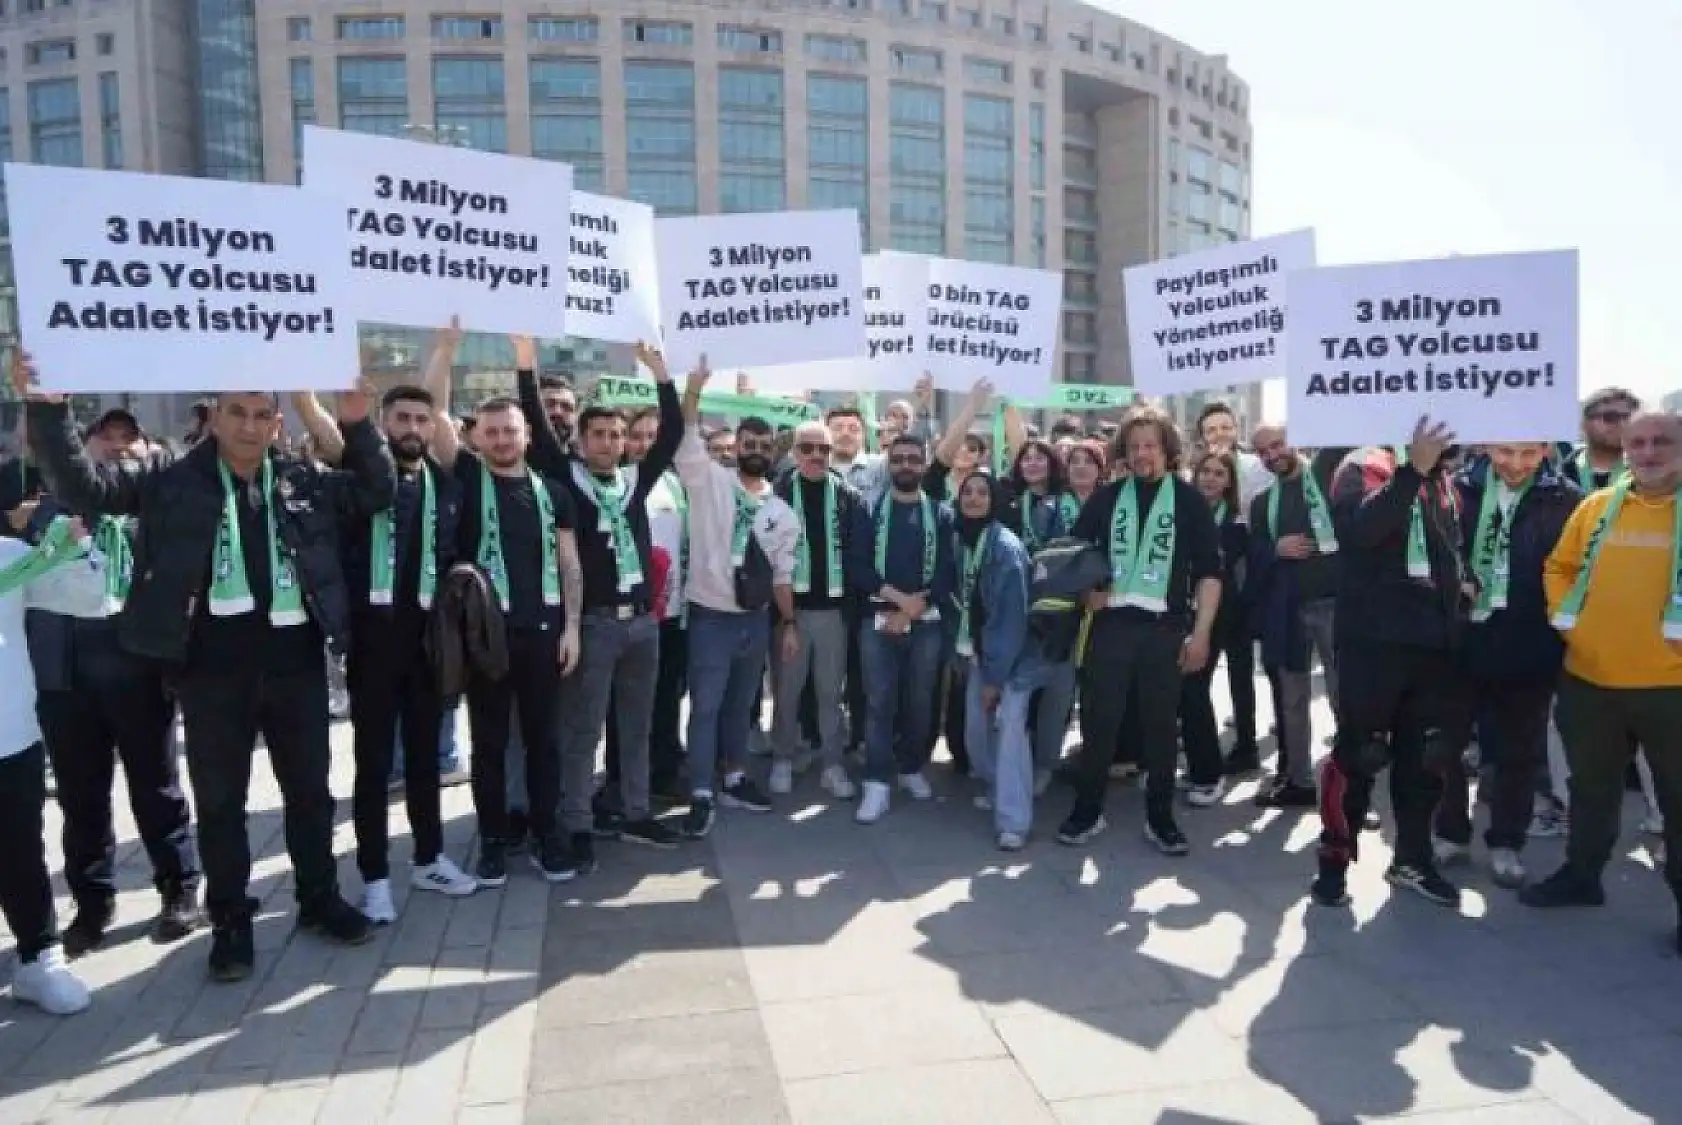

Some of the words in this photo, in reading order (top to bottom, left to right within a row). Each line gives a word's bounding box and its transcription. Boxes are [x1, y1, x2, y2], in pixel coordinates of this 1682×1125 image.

[375, 175, 394, 199] 3
[399, 180, 508, 215] Milyon
[106, 216, 130, 245] 3
[137, 218, 274, 258] Milyon
[412, 216, 538, 252] Yolcusu
[438, 249, 549, 290] İstiyor!
[709, 247, 724, 268] 3
[729, 243, 811, 270] Milyon
[61, 258, 152, 288] TAG
[159, 263, 315, 293] Yolcusu
[685, 277, 737, 300] TAG
[741, 273, 838, 296] Yolcusu
[1156, 255, 1278, 296] Paylaşımlı
[946, 285, 982, 306] bin
[986, 290, 1030, 311] TAG
[1170, 286, 1269, 318] Yolculuk
[1357, 300, 1373, 323] 3
[1382, 294, 1501, 327] Milyon
[48, 301, 190, 330] Adalet
[197, 298, 335, 341] İstiyor!
[677, 304, 760, 331] Adalet
[1321, 336, 1388, 360] TAG
[1396, 330, 1538, 356] Yolcusu
[600, 379, 650, 397] TAG
[1306, 370, 1418, 396] Adalet
[1425, 362, 1554, 398] İstiyor!
[1148, 513, 1173, 564] TAG
